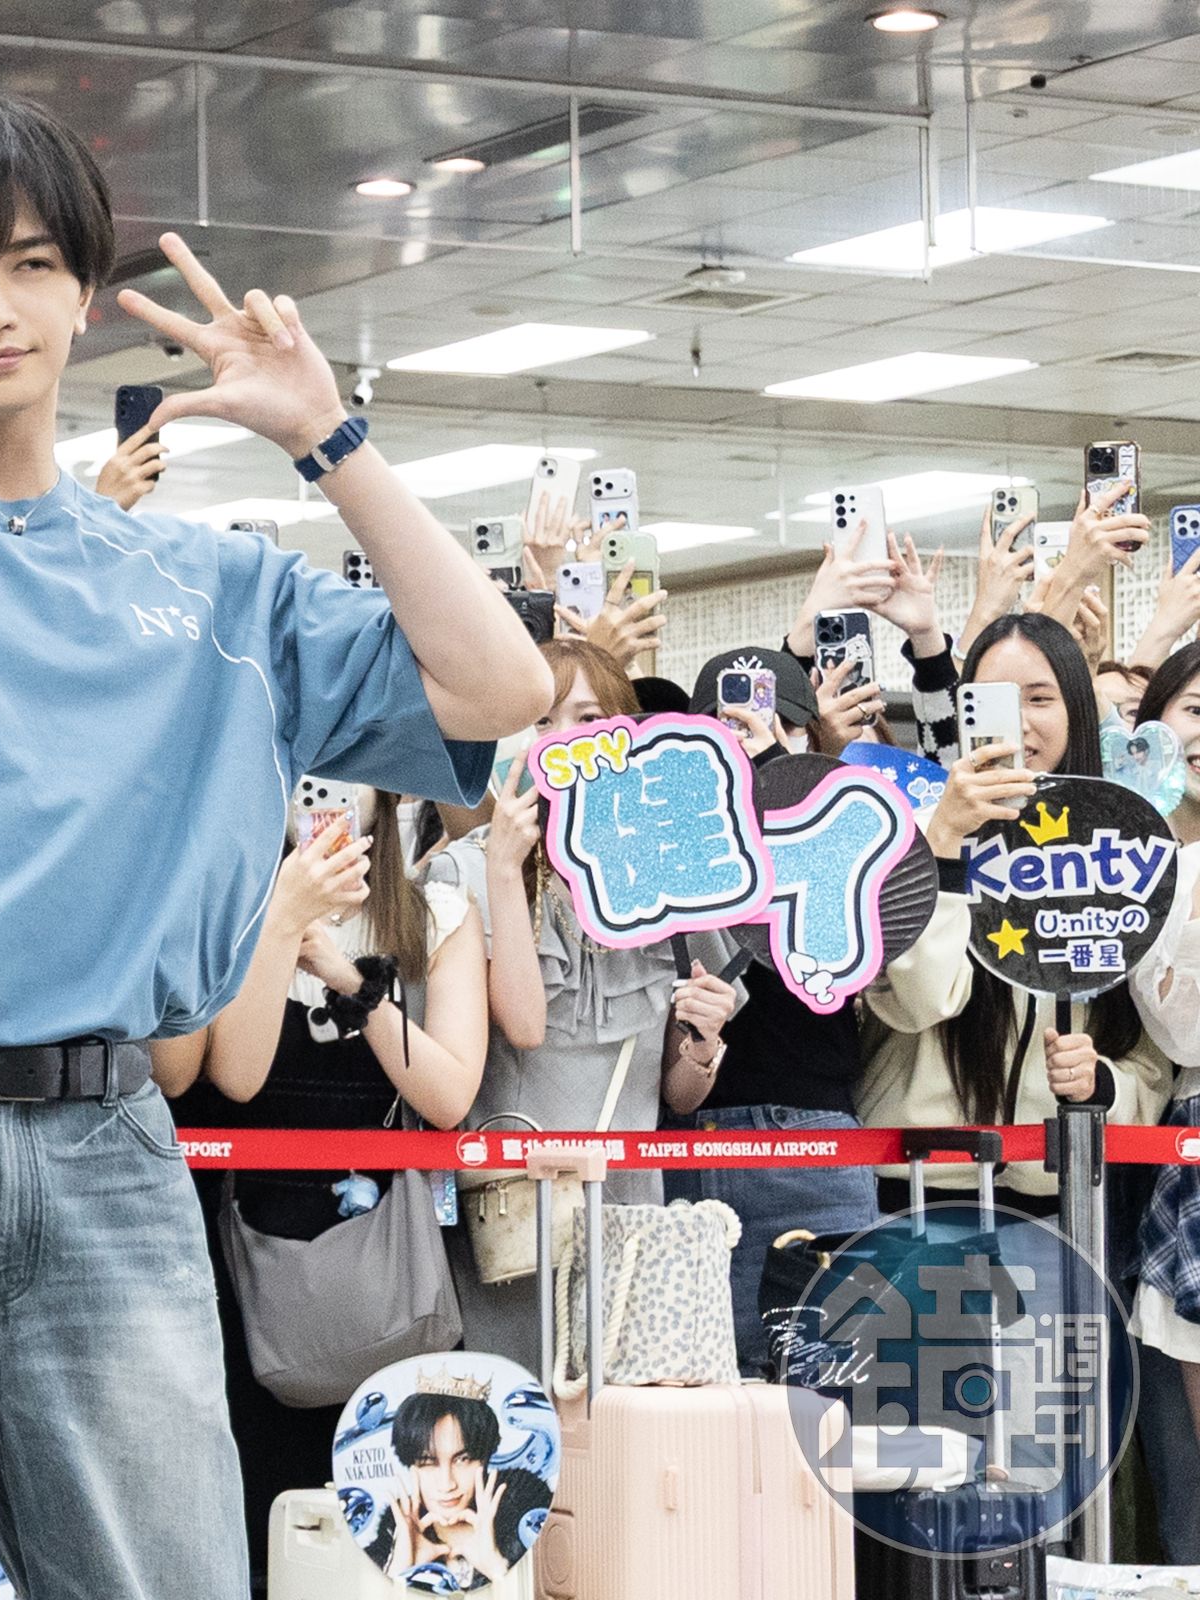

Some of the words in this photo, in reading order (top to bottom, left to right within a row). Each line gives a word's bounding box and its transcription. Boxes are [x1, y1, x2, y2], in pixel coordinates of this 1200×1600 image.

[542, 728, 632, 788] STY
[960, 836, 1167, 895] Kenty
[1042, 943, 1121, 968] 一番星
[177, 1141, 232, 1157] RPORT
[637, 1142, 688, 1157] TAIPEI
[693, 1141, 772, 1157] SONGSHAN
[773, 1141, 838, 1156] AIRPORT
[352, 1447, 386, 1465] KENTO
